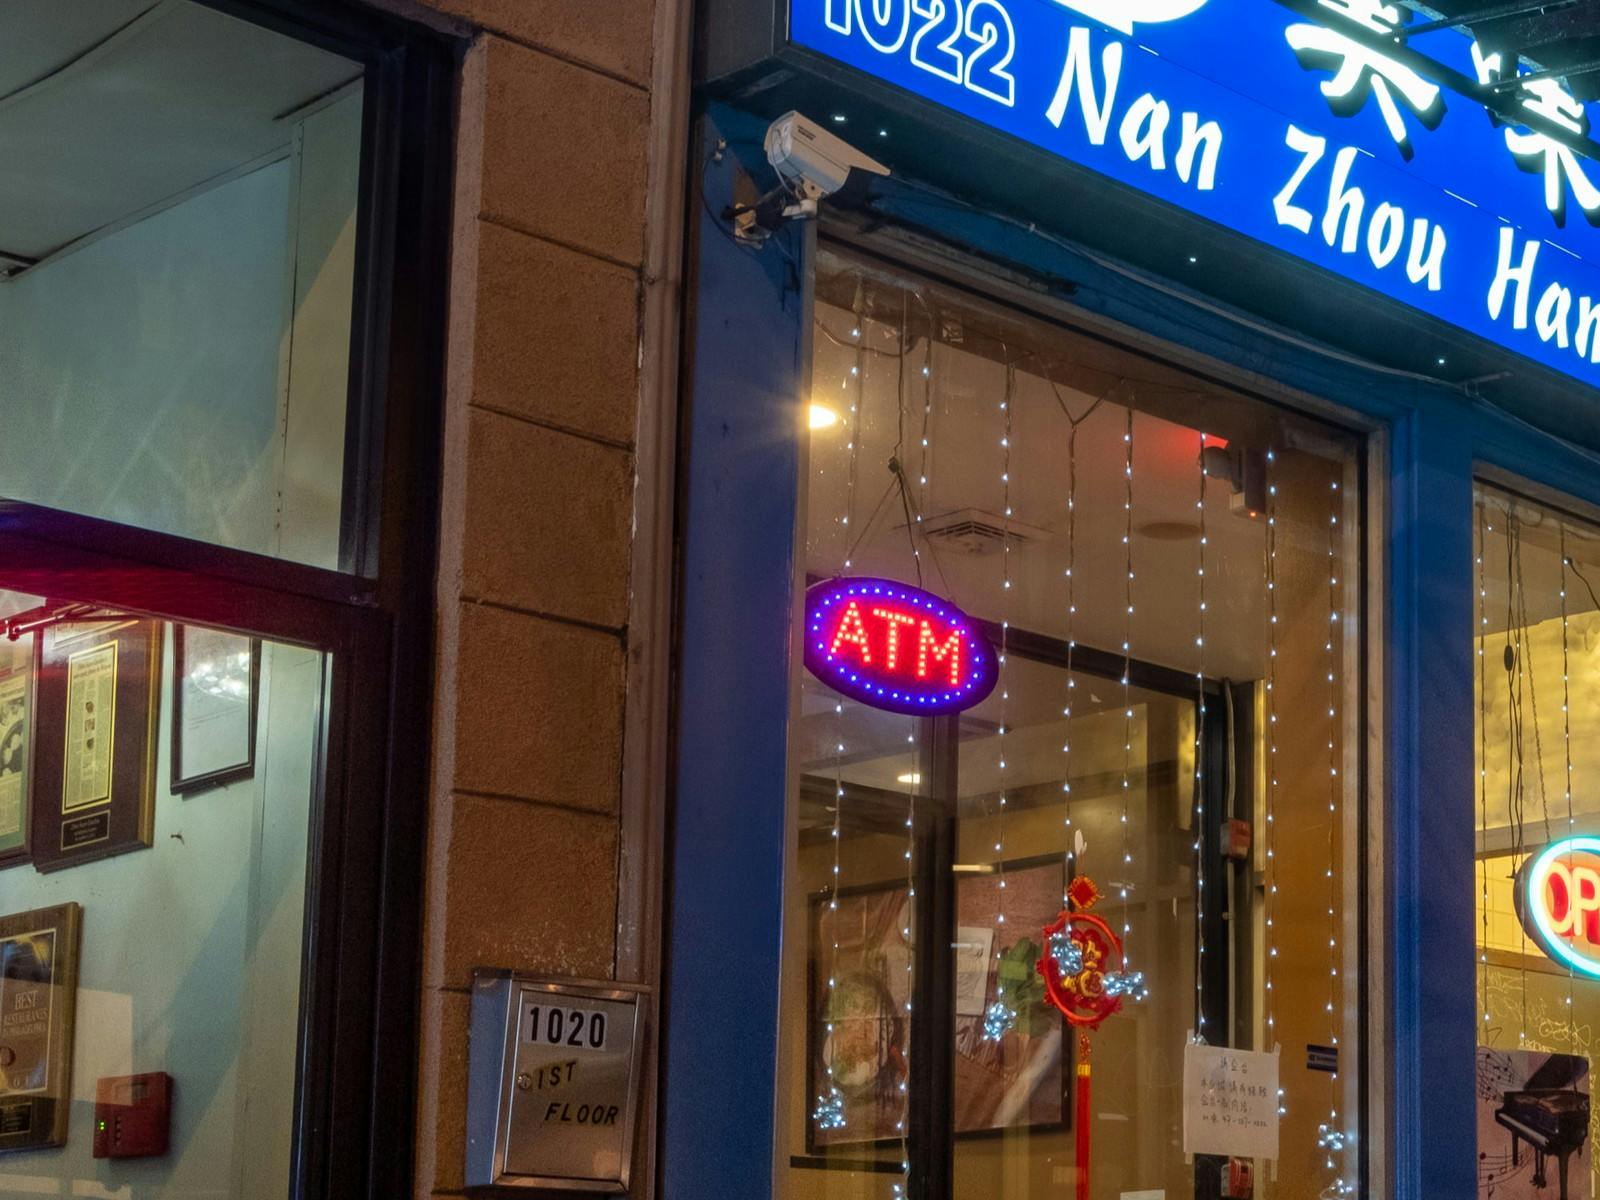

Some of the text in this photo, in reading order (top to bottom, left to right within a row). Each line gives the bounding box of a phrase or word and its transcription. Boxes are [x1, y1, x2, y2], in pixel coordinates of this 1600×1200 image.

[1046, 27, 1222, 189] Nan
[1273, 125, 1446, 290] Zhou
[830, 601, 961, 685] ATM
[530, 1006, 605, 1048] 1020
[544, 1102, 619, 1125] FLOOR
